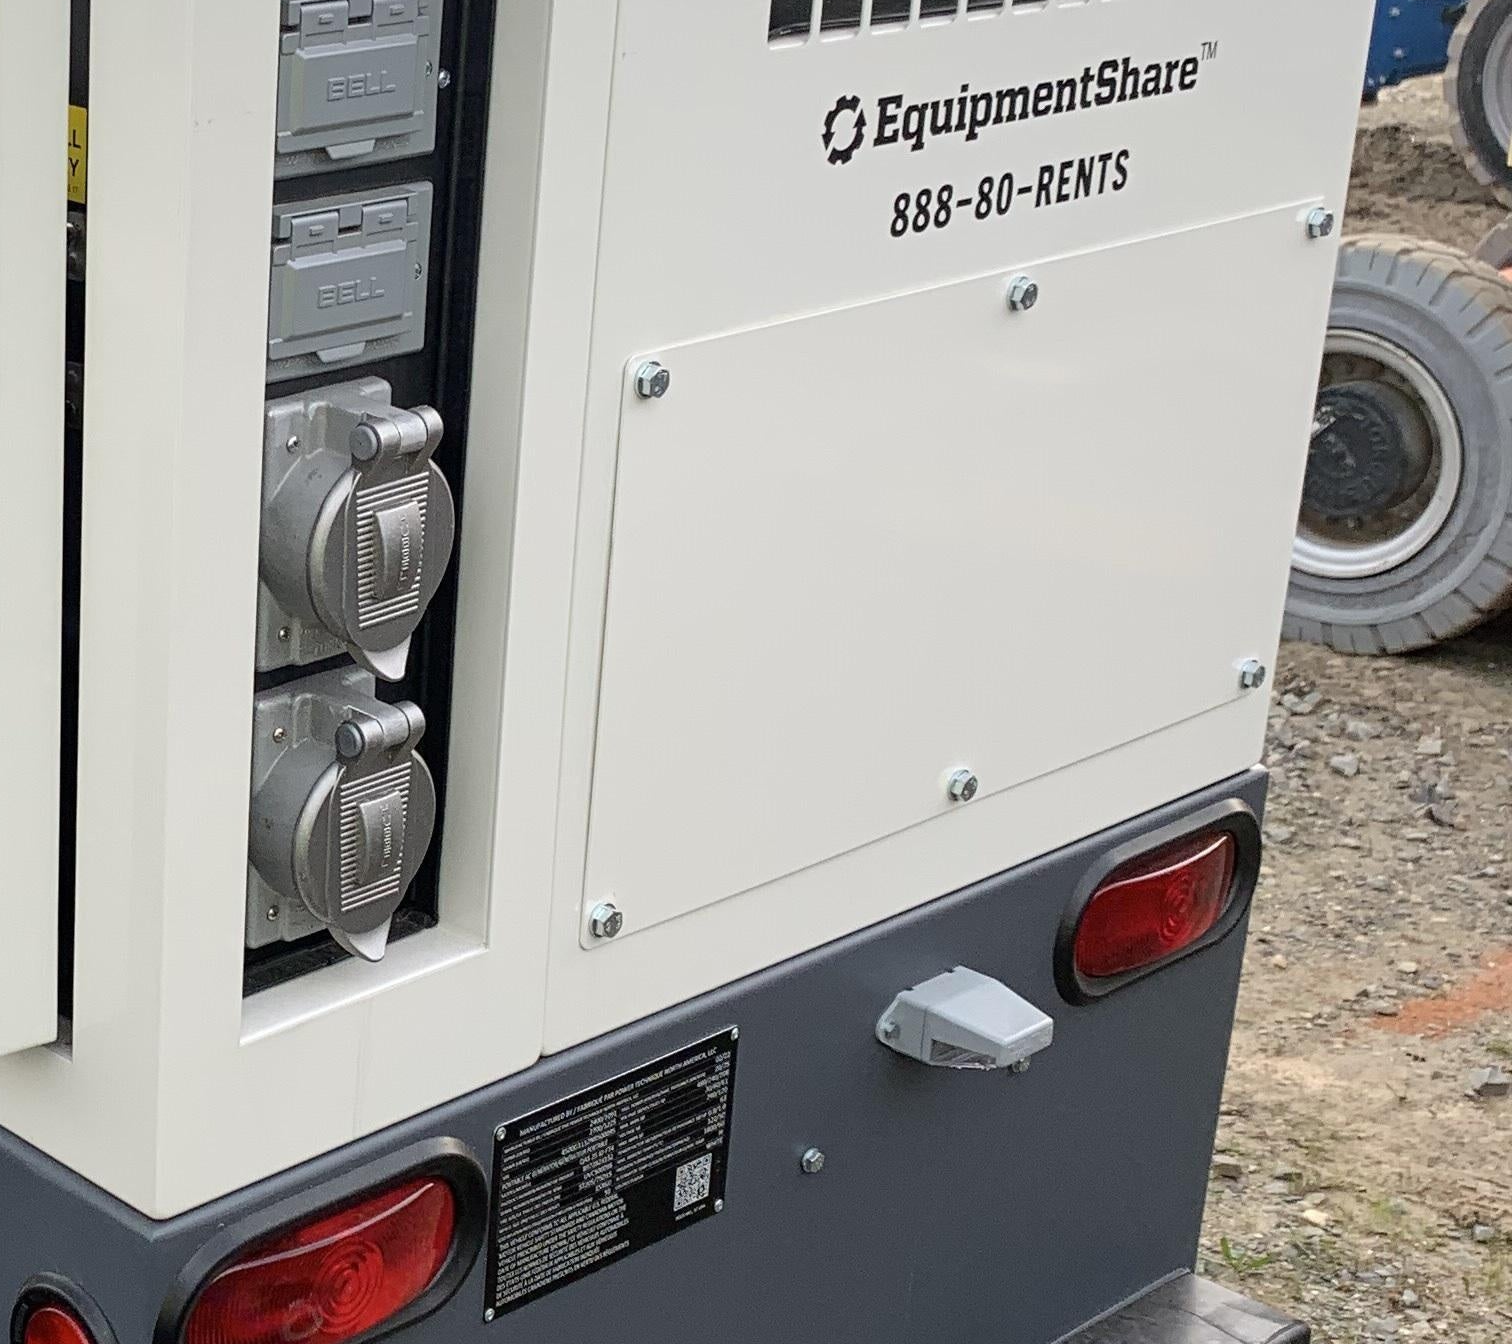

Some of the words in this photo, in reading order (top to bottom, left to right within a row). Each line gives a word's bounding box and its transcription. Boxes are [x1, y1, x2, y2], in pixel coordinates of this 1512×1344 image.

[327, 69, 397, 102] BELL
[873, 52, 1199, 151] EquipmentShare
[890, 148, 1130, 237] 888-80-RENTS
[317, 275, 385, 309] BELL
[519, 1111, 565, 1137] MANUFACTURED
